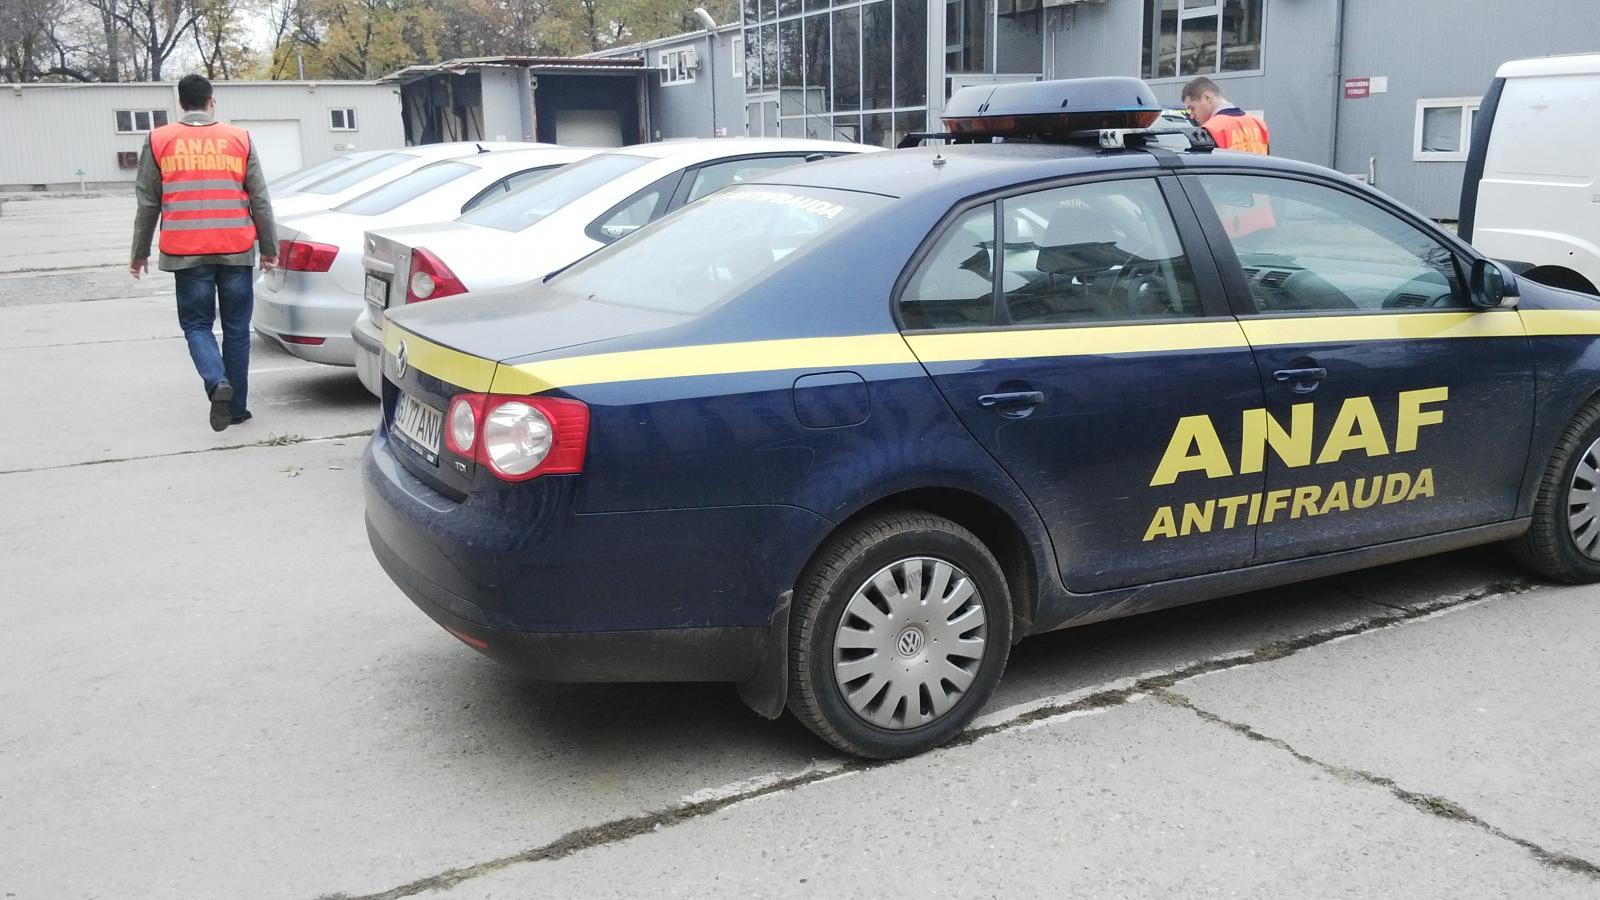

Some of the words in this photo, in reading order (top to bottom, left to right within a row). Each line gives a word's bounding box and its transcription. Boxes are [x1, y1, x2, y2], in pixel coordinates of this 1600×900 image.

[175, 138, 228, 155] ANAF
[1149, 386, 1449, 487] ANAF
[1142, 468, 1435, 542] ANTIFRAUDA
